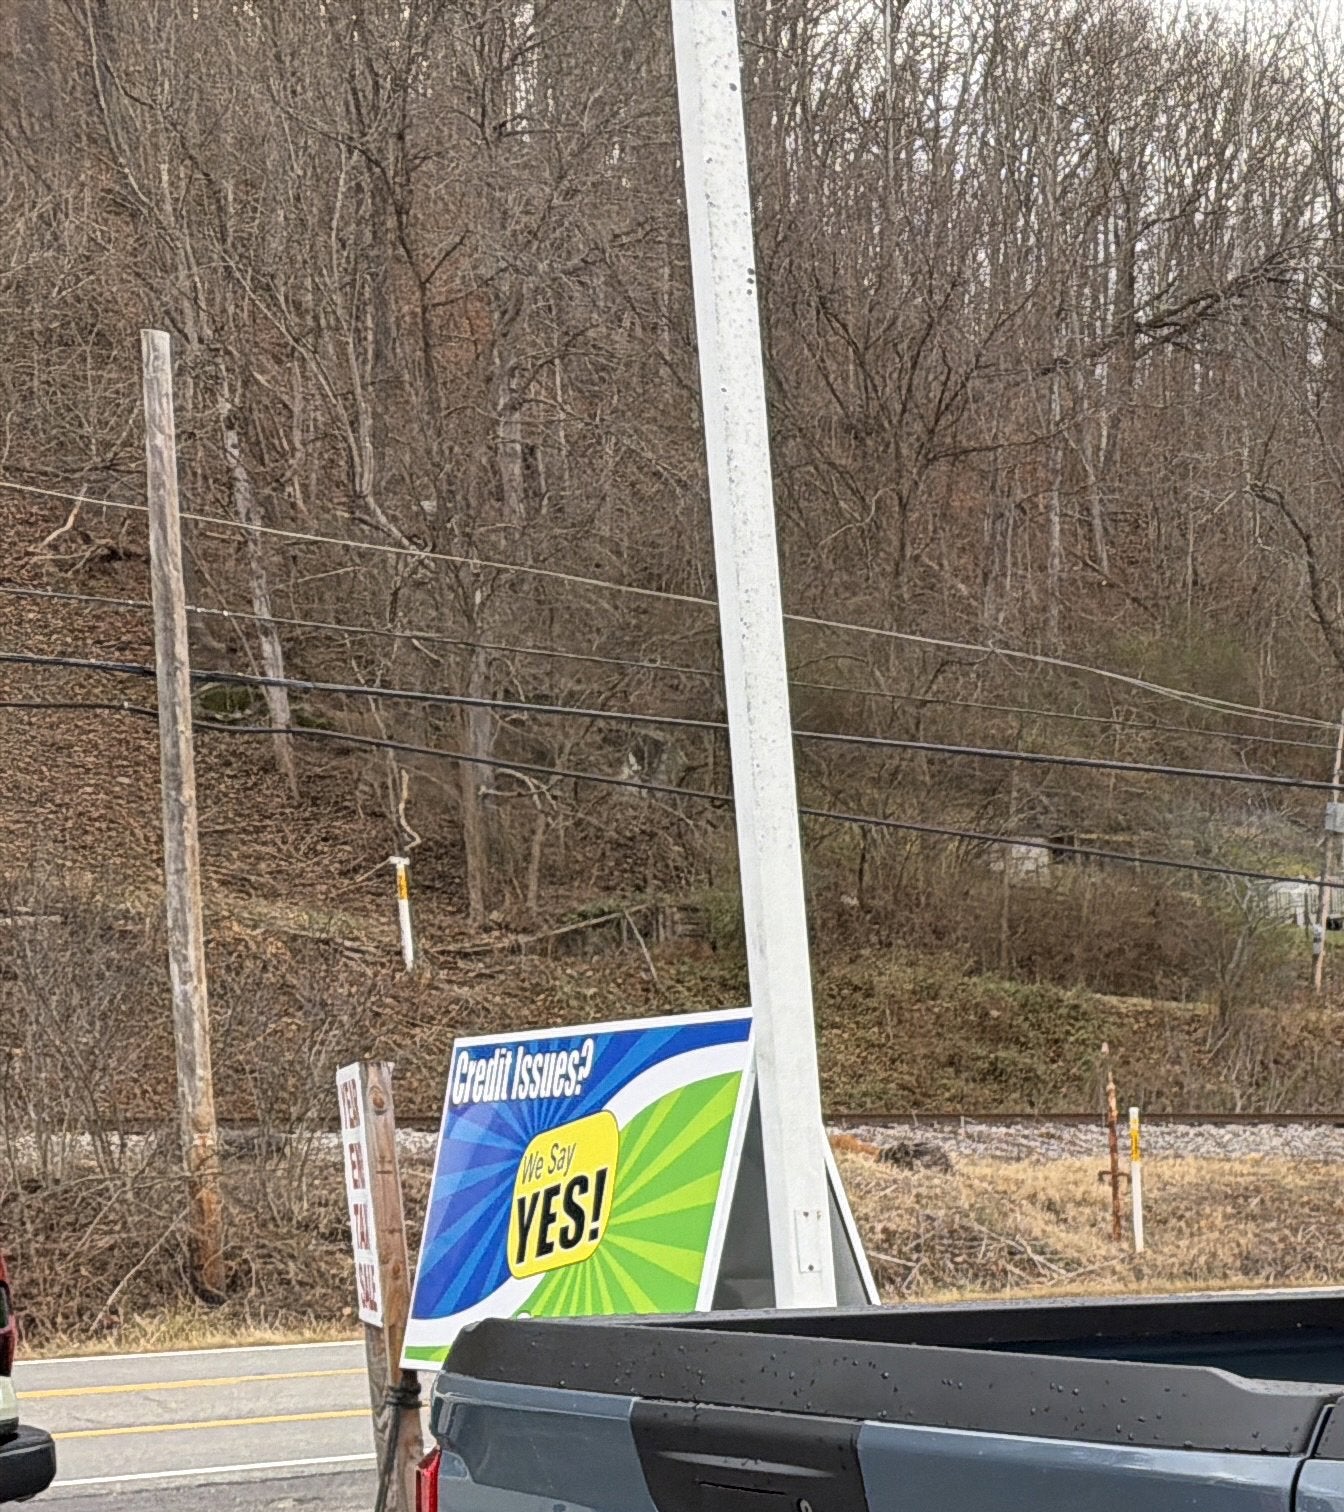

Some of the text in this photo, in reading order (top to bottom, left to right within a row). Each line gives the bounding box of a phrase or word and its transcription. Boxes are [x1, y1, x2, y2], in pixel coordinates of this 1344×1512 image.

[452, 1037, 595, 1105] Credit Issues?
[522, 1142, 577, 1184] We Say
[515, 1167, 609, 1265] YES!
